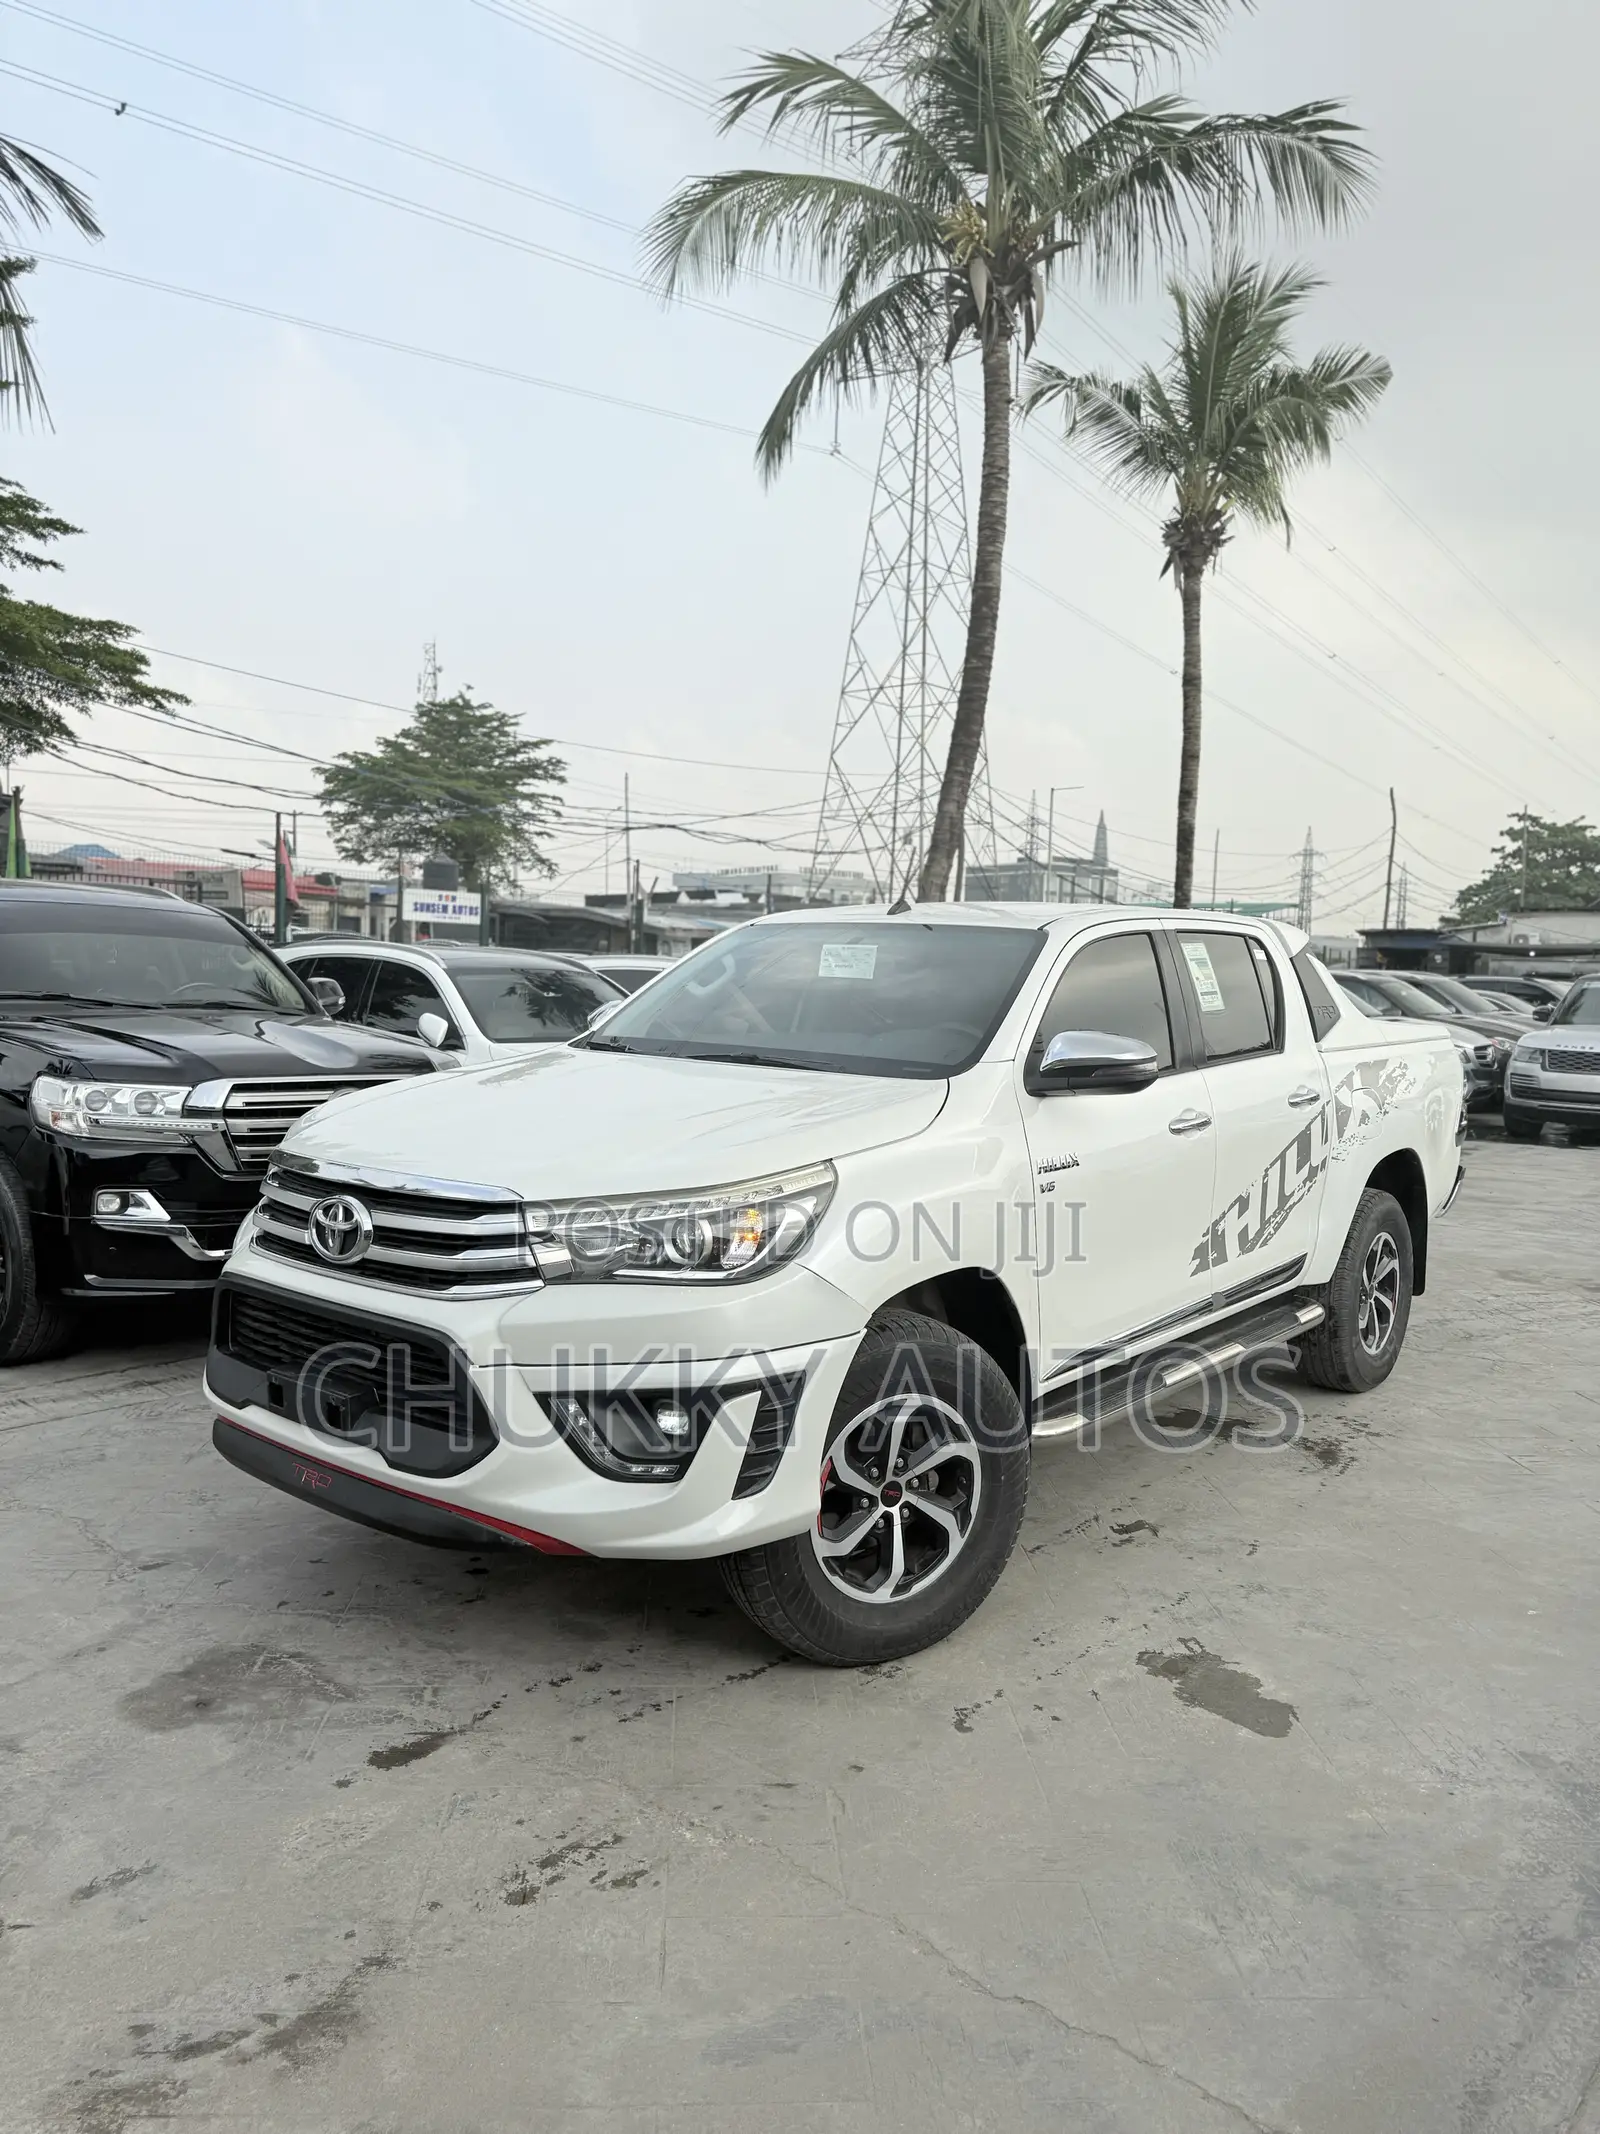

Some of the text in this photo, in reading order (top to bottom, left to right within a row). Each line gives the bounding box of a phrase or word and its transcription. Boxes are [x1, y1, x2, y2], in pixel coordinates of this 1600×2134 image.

[452, 904, 479, 916] AUTOS
[1313, 1005, 1336, 1019] TRD
[1036, 1152, 1079, 1175] HILUX
[1040, 1181, 1055, 1194] V6
[292, 1462, 332, 1489] TRD
